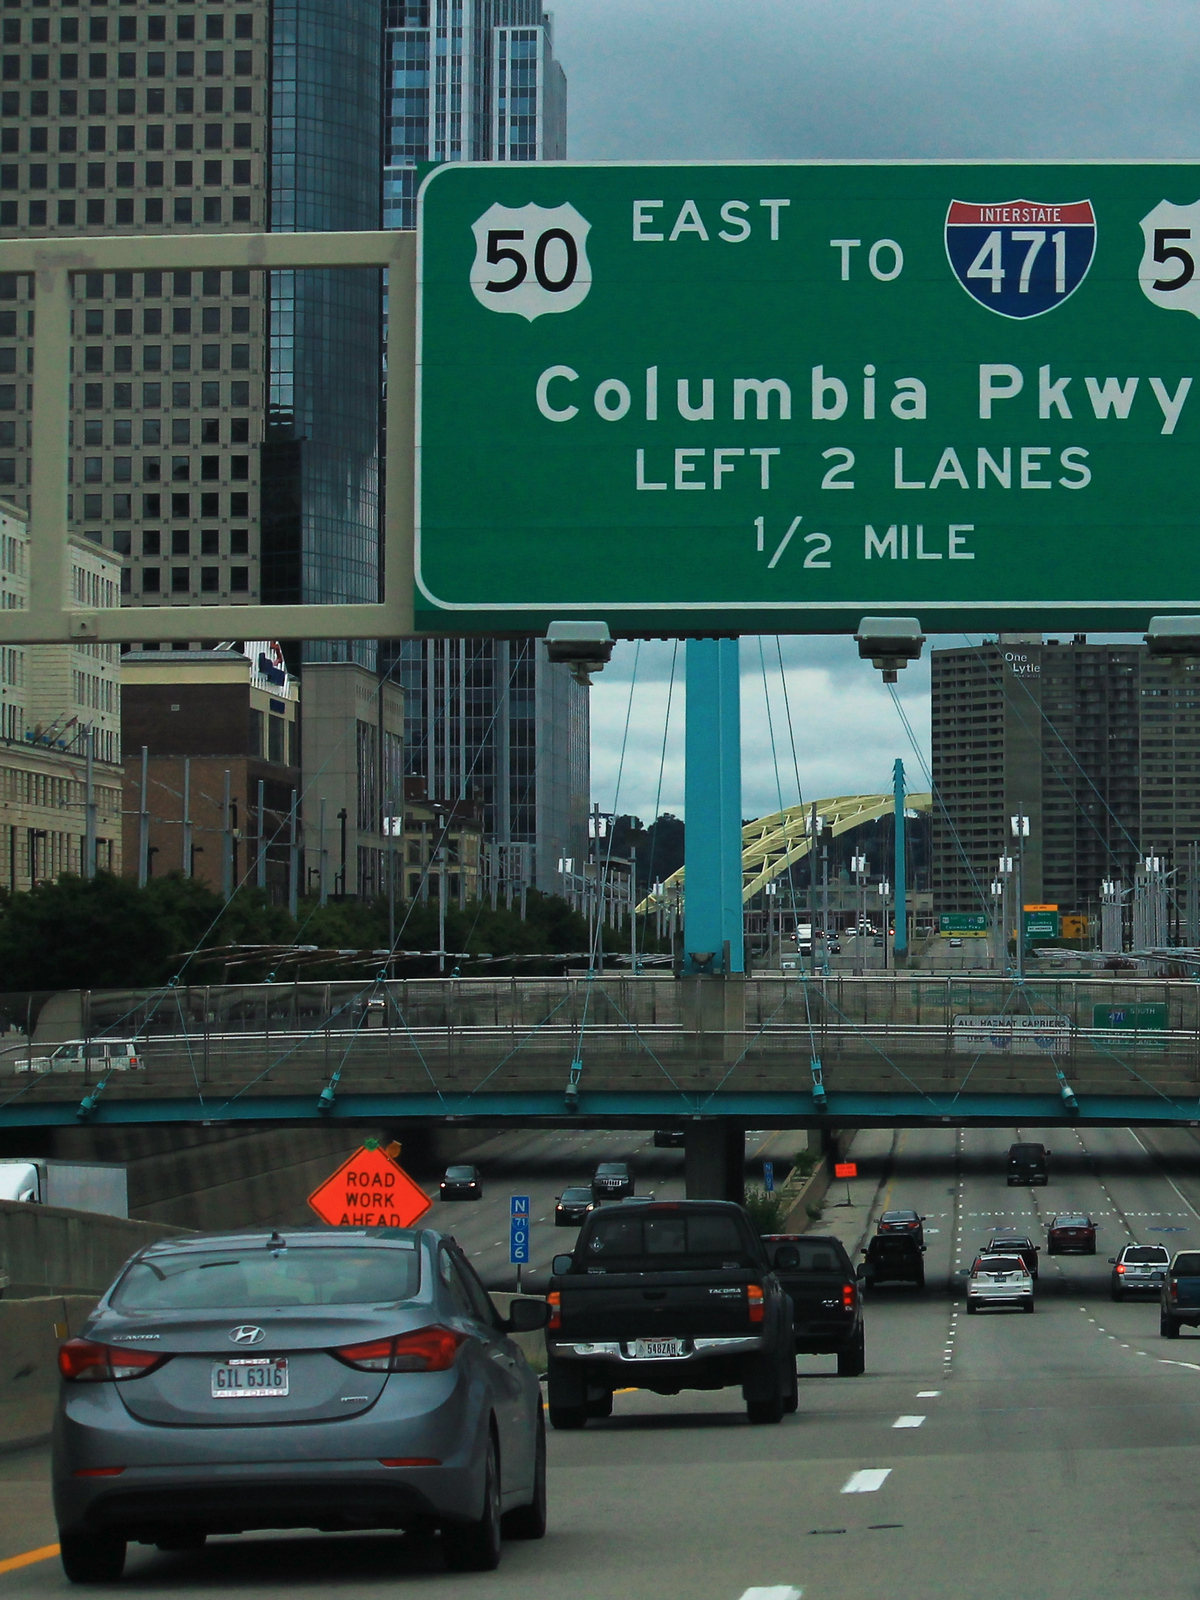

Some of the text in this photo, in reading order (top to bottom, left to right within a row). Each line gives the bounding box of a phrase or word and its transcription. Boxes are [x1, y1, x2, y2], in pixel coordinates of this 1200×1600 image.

[633, 199, 790, 242] EAST
[979, 205, 1062, 222] INTERSTATE
[485, 228, 577, 292] 50
[830, 239, 903, 281] TO
[967, 231, 1067, 293] 471
[536, 364, 1192, 434] Columbia Pkwy
[637, 447, 1092, 490] LEFT 2 LANES
[754, 516, 974, 568] 1/2 MILE
[1005, 652, 1028, 662] One
[1012, 663, 1041, 674] Lytle
[1108, 1012, 1125, 1021] 471
[1130, 1007, 1156, 1015] SOUTH
[347, 1172, 395, 1187] ROAD
[346, 1193, 394, 1208] WORK
[514, 1199, 526, 1213] N
[340, 1213, 400, 1227] AHEAD
[514, 1217, 526, 1227] 71
[514, 1246, 525, 1259] 6
[217, 1368, 282, 1388] GIL 6316
